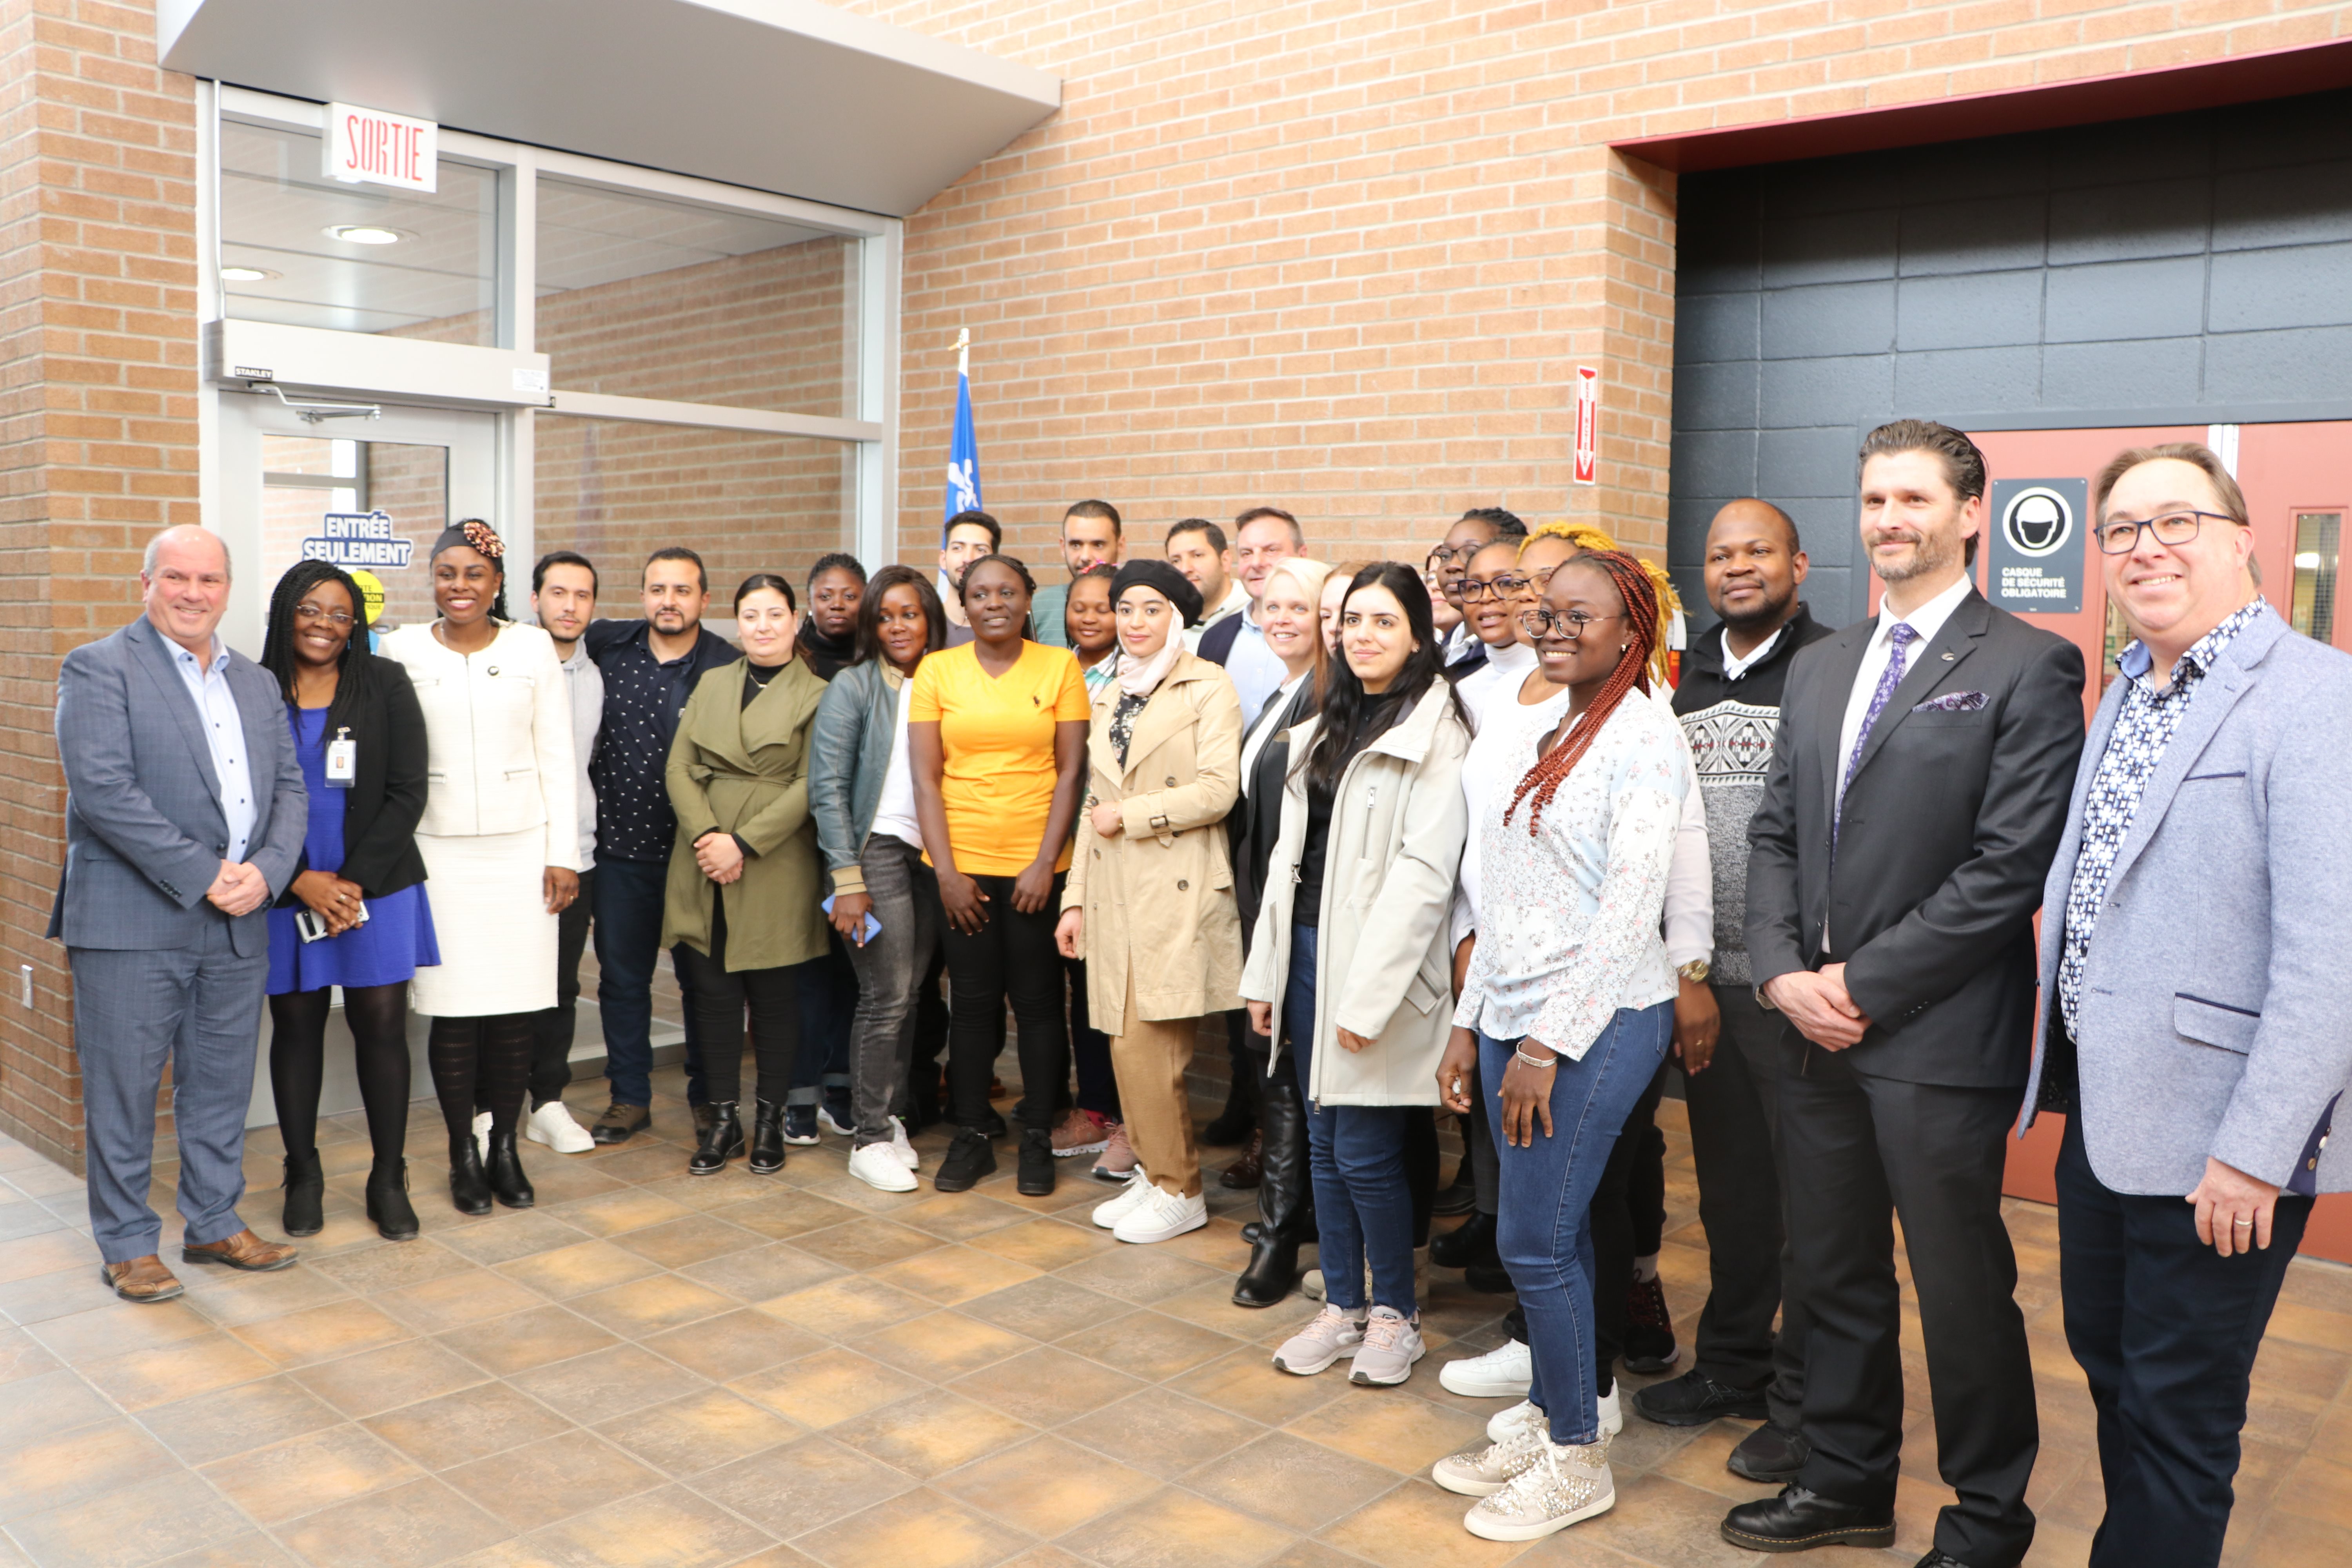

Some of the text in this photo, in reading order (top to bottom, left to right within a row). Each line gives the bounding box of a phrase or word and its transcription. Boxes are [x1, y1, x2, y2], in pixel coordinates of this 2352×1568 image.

[347, 114, 423, 181] SORTIE
[236, 367, 272, 378] STANLEY
[326, 514, 389, 539] ENTRÉE
[303, 540, 410, 564] SEULEMENT
[2002, 567, 2043, 577] CASQUE
[2002, 576, 2065, 588] DE SÉCURITÉ
[2001, 588, 2067, 598] OBLIGATOIRE
